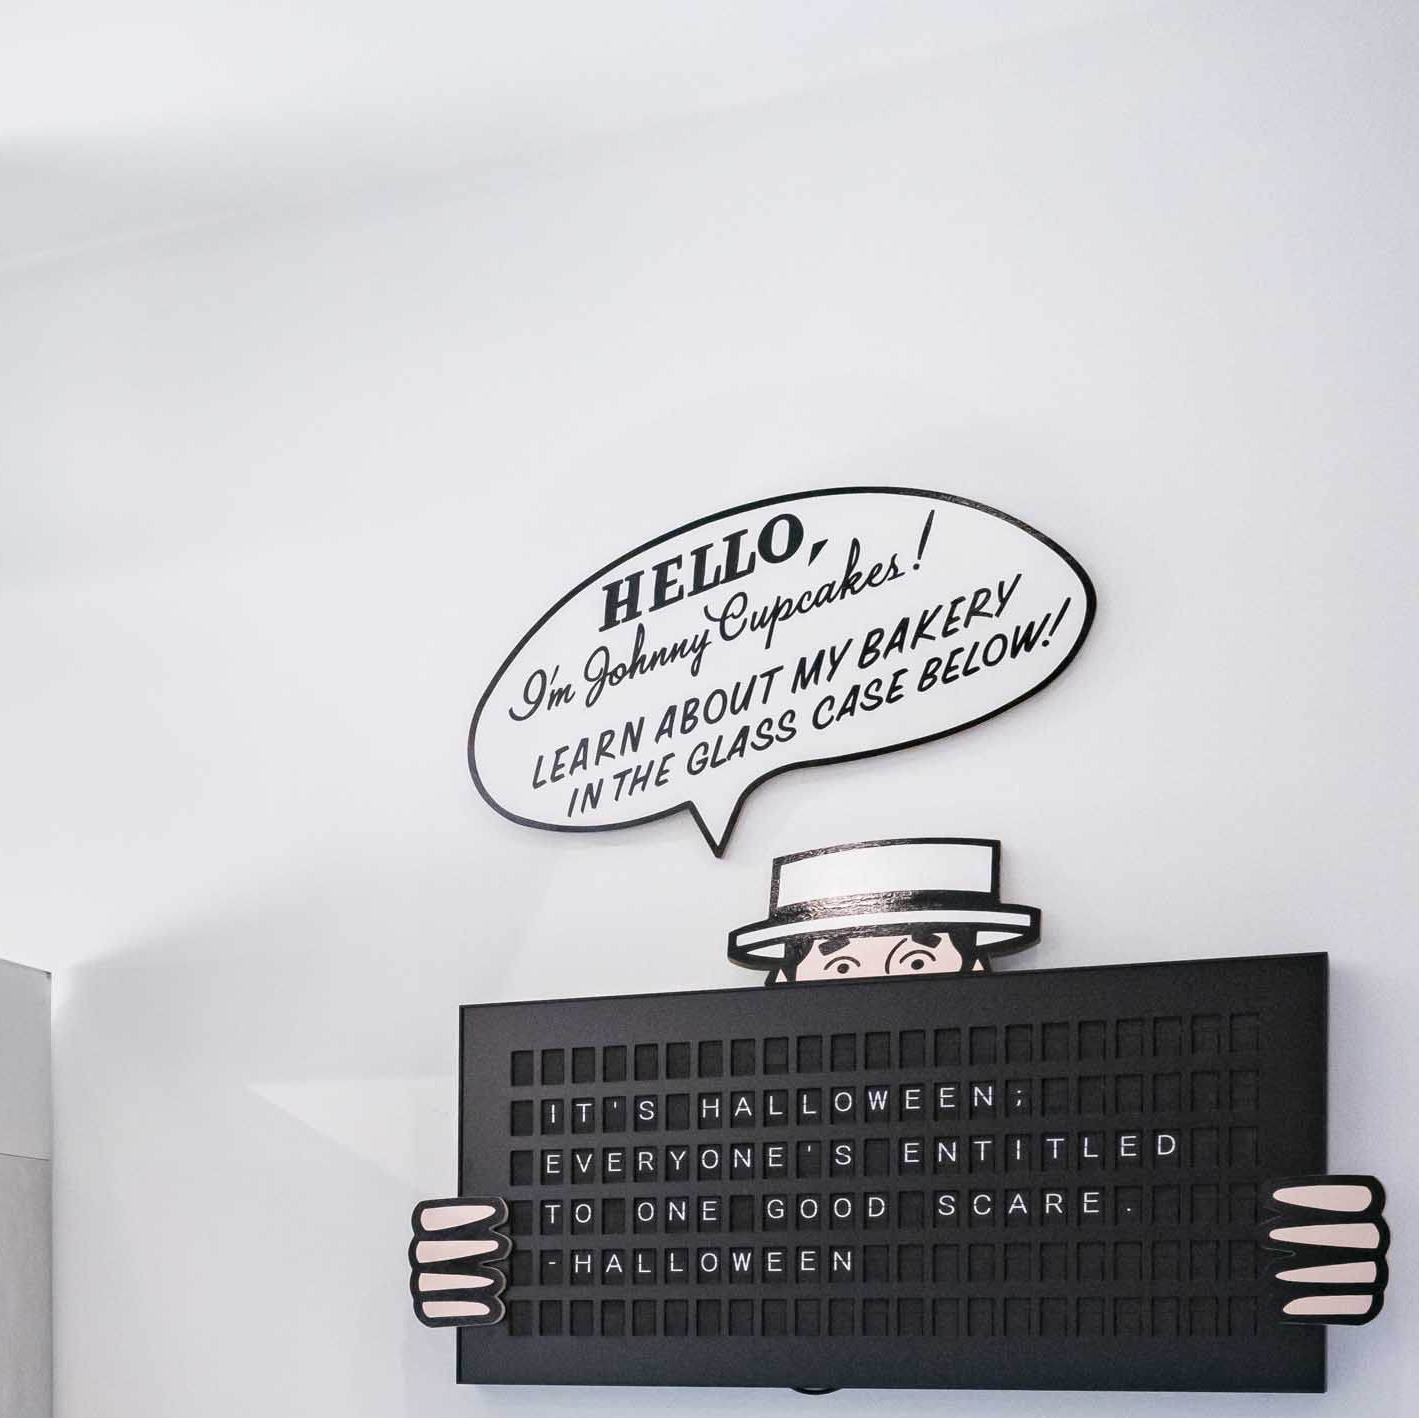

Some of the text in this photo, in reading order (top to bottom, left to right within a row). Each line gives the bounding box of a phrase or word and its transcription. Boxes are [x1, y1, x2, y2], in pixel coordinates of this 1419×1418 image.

[597, 511, 830, 633] HELLO,
[508, 665, 576, 722] I'm
[584, 623, 711, 707] Johnny
[532, 572, 1023, 790] LEARN ABOUT MY BAKERY
[567, 596, 1073, 819] IN THE GLASS CASE BELOW!
[548, 1083, 1026, 1126] IT'S HALLOWEEN;
[544, 1133, 1179, 1177] EVERYONE'S ENTITLED
[544, 1189, 1135, 1227] TO ONE GOOD SCARE.
